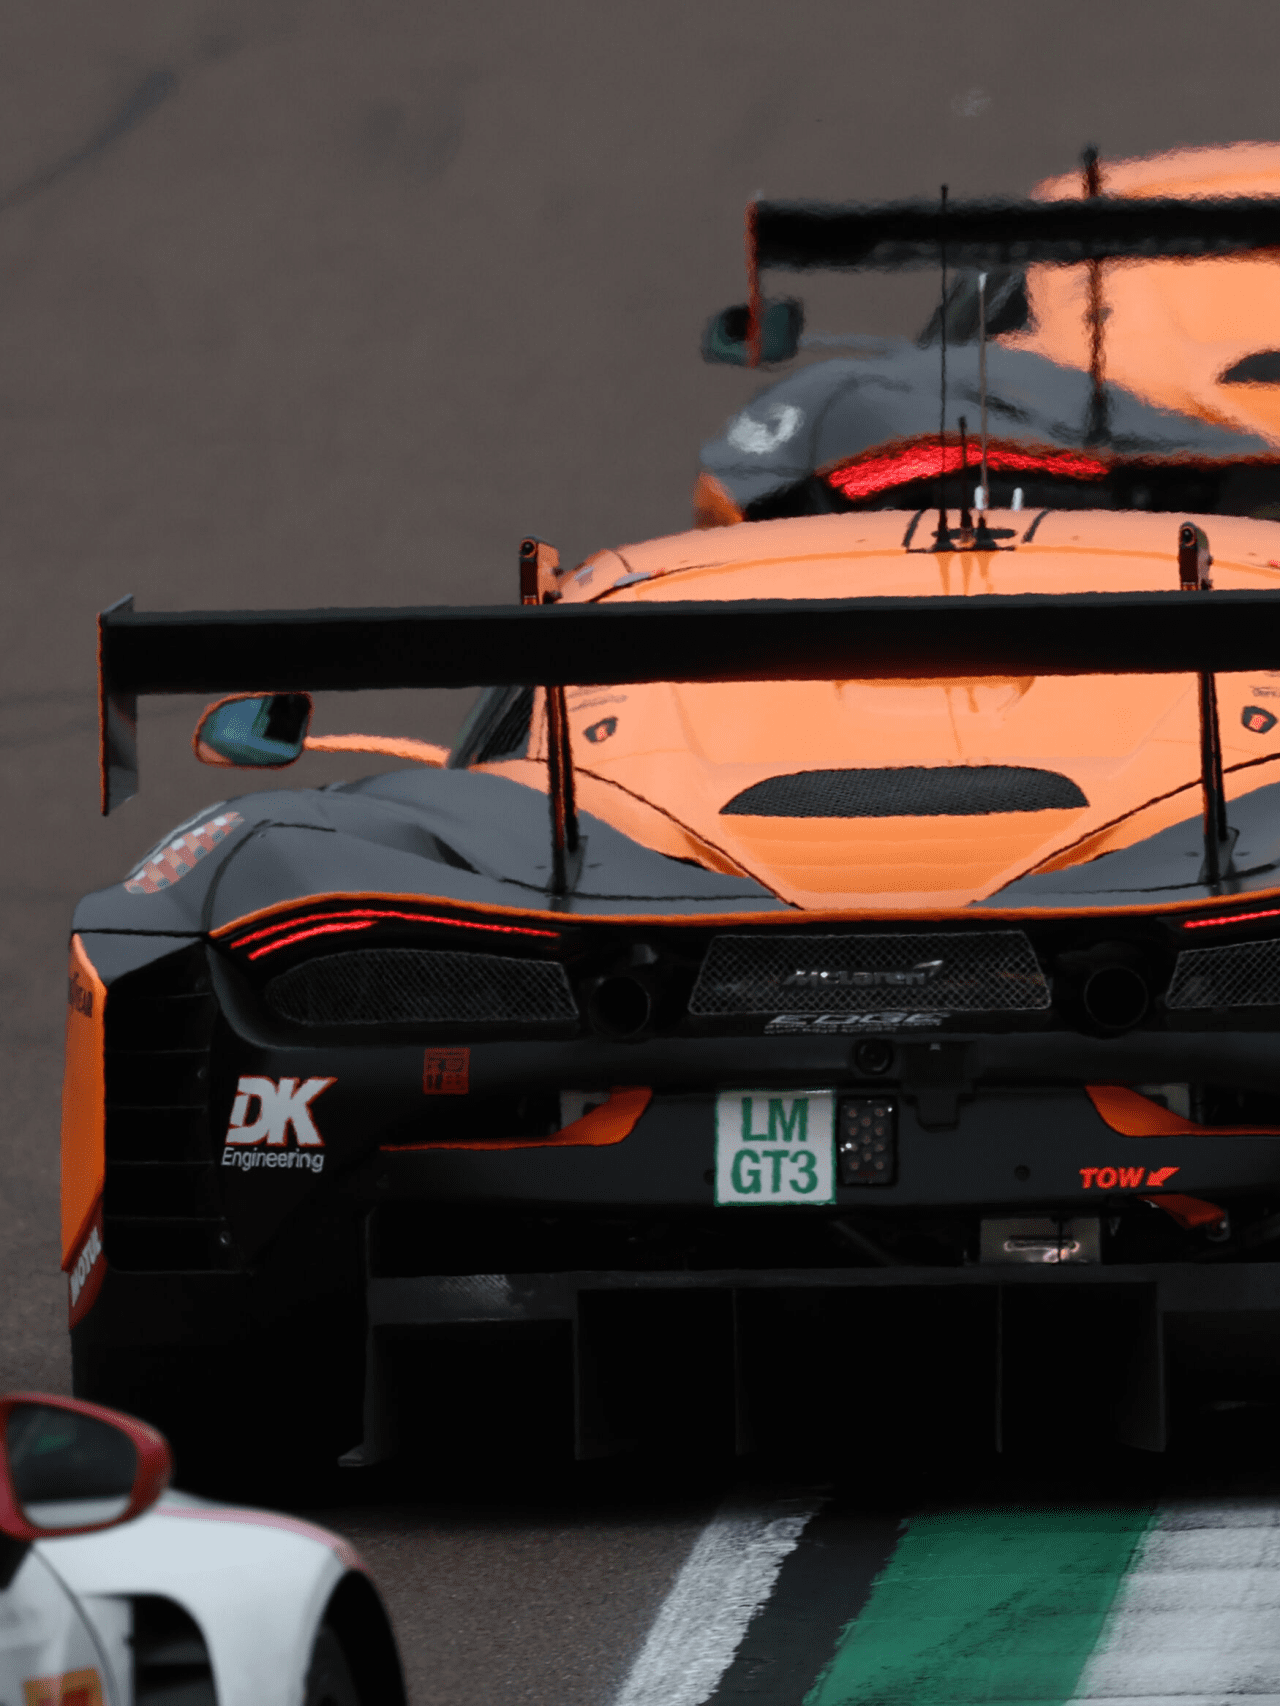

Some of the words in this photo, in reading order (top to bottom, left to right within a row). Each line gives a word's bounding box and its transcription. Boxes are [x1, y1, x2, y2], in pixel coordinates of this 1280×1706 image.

[224, 1074, 338, 1147] DK
[741, 1096, 810, 1142] LM
[221, 1146, 325, 1172] Engineering
[731, 1148, 819, 1194] GT3
[1079, 1166, 1146, 1190] TOW
